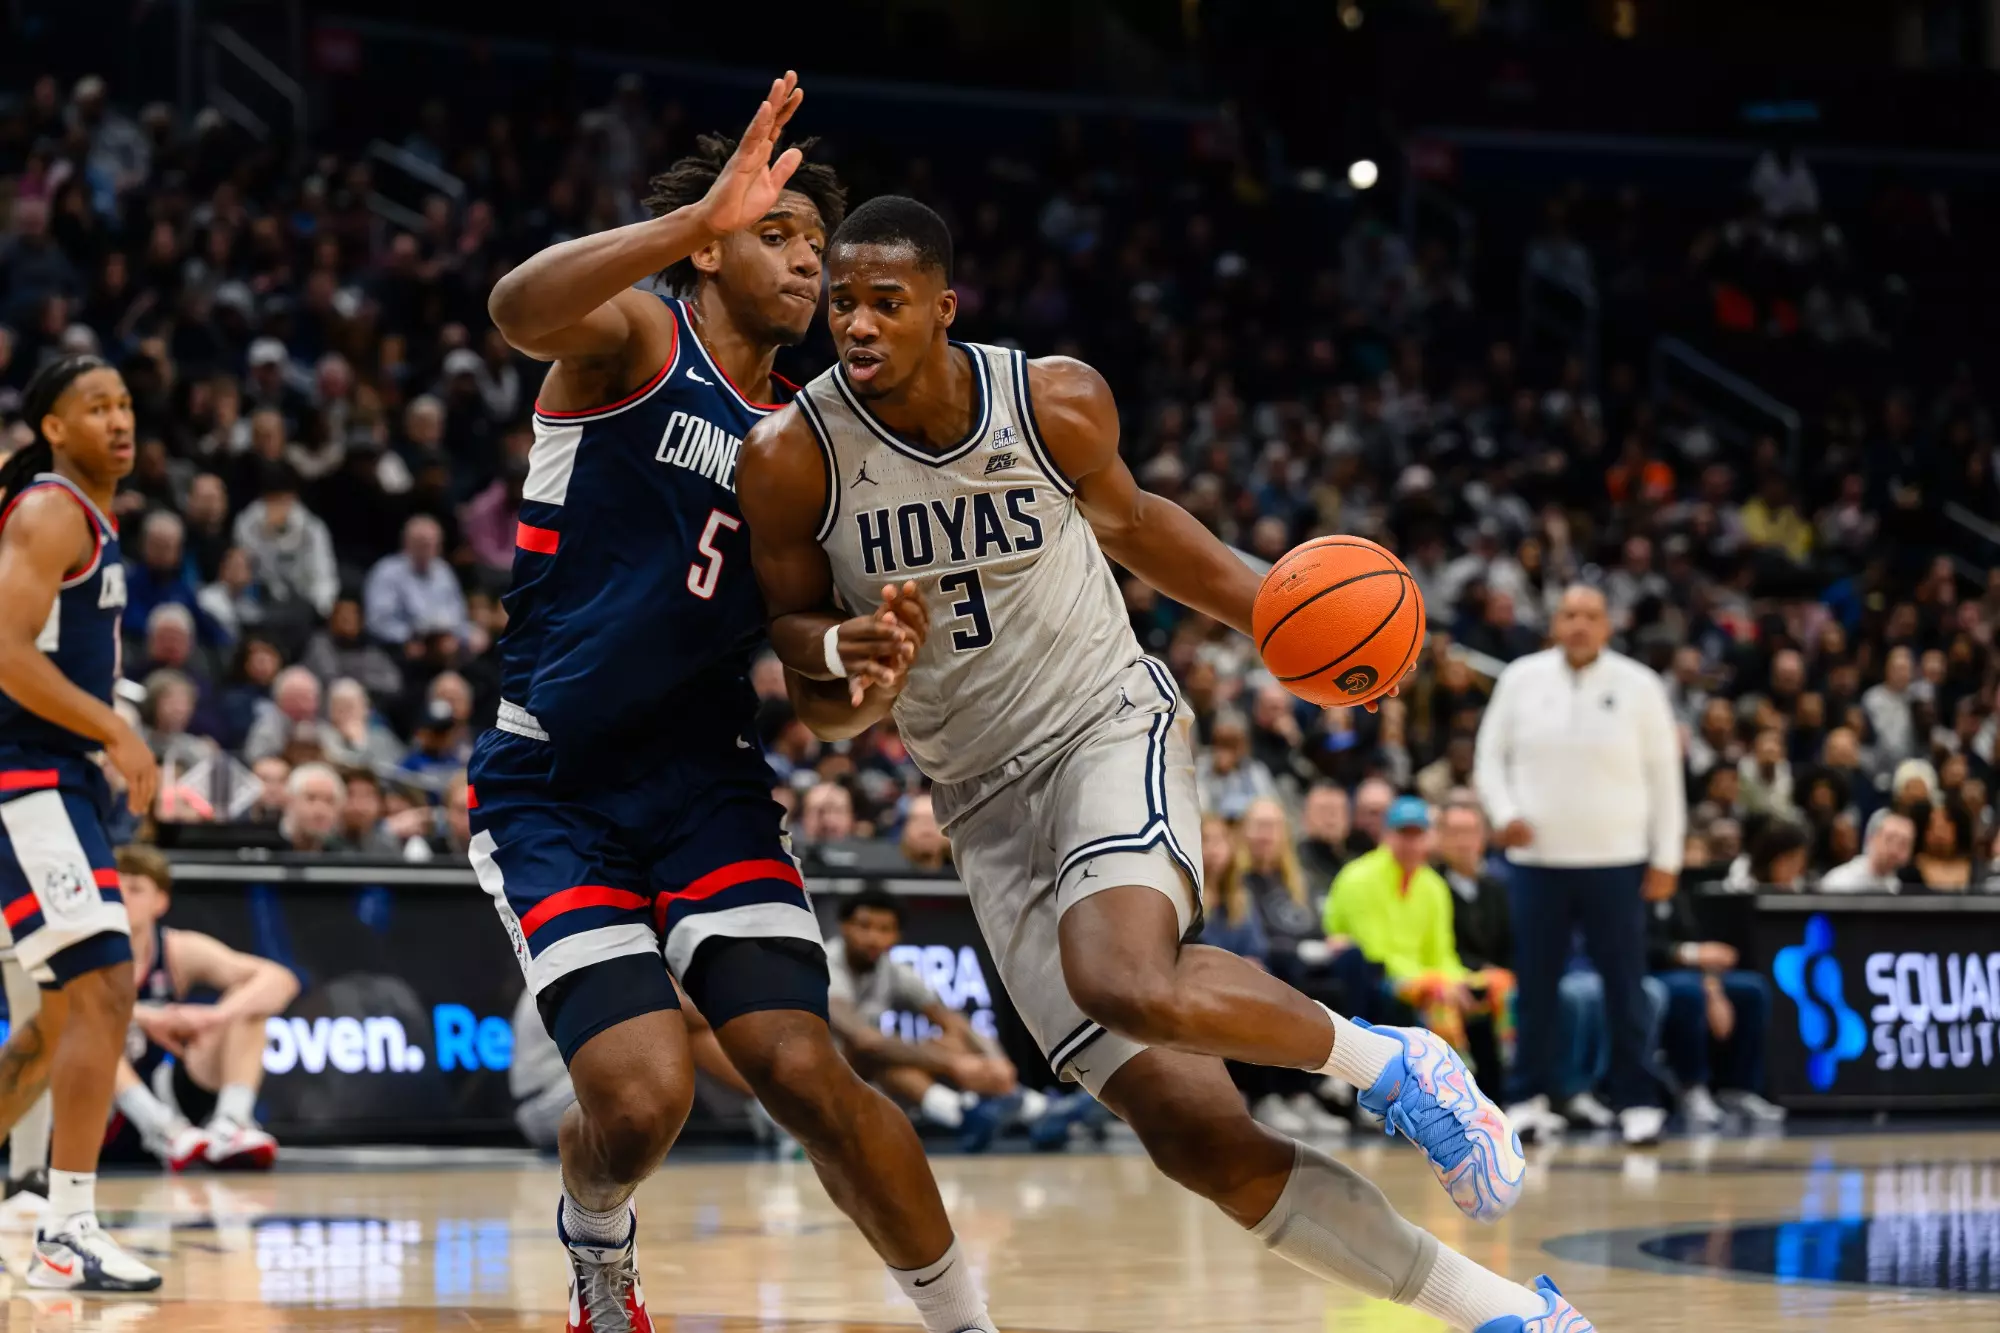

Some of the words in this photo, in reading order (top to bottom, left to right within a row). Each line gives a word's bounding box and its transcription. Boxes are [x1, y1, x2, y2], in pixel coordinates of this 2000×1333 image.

[655, 411, 743, 494] CONNE
[988, 452, 1012, 463] BIG
[992, 435, 1019, 449] CHAN
[994, 429, 1005, 440] BE
[985, 458, 1018, 471] EAST
[687, 507, 742, 599] 5
[855, 487, 1044, 575] HOYAS
[938, 567, 996, 653] 3
[1872, 1022, 2000, 1070] SOLUT
